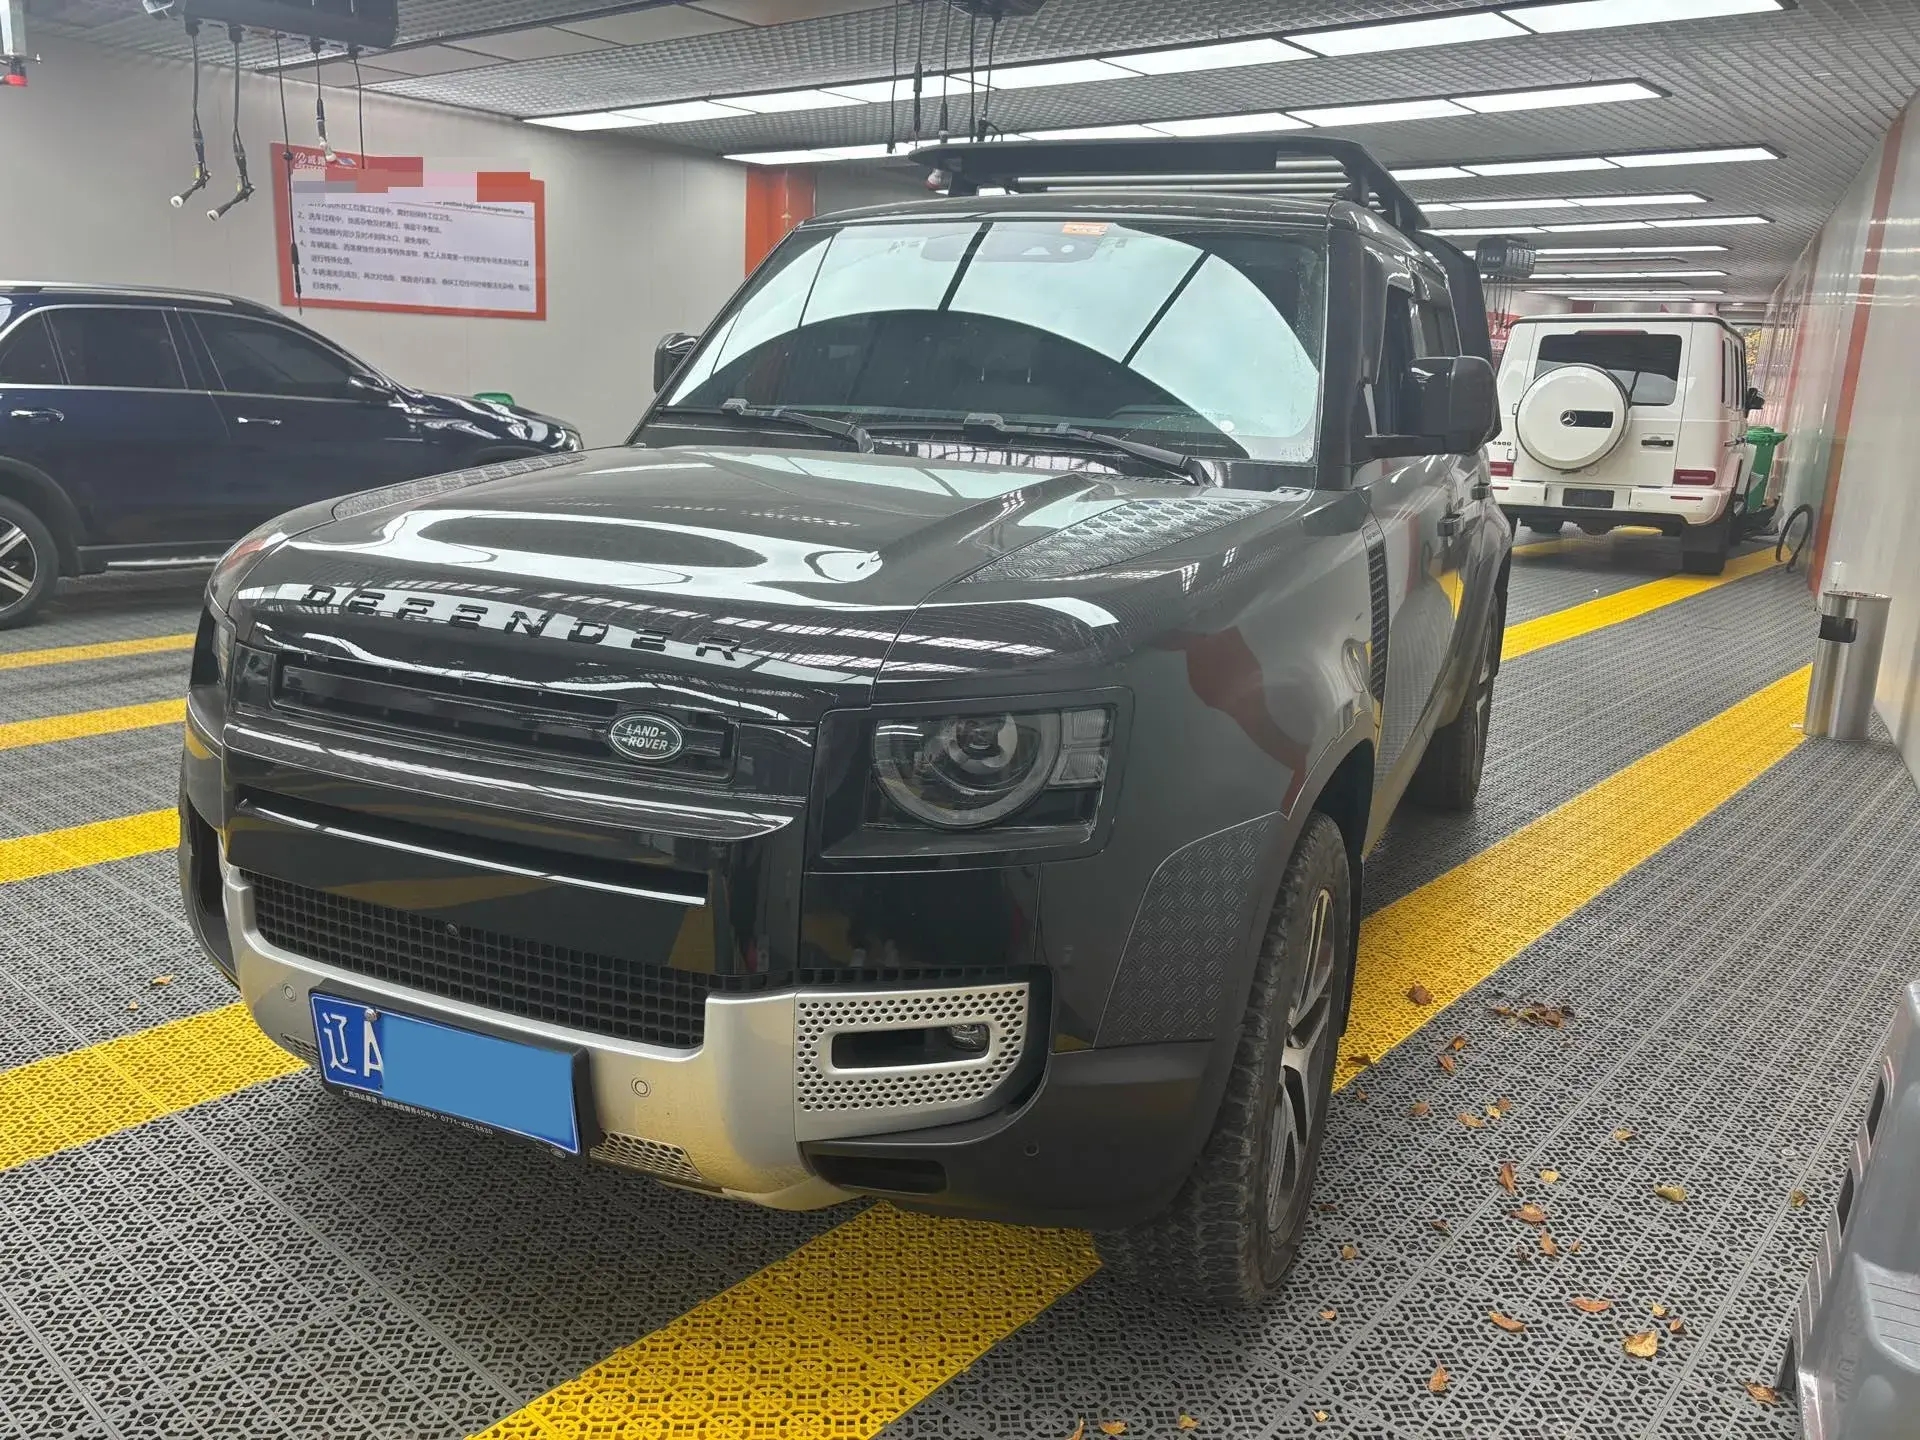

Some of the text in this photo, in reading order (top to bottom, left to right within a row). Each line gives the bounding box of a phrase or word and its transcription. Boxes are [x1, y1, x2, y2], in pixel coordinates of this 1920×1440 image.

[299, 585, 742, 662] DEFENDER
[626, 723, 660, 738] LAND
[627, 736, 668, 751] ROVER
